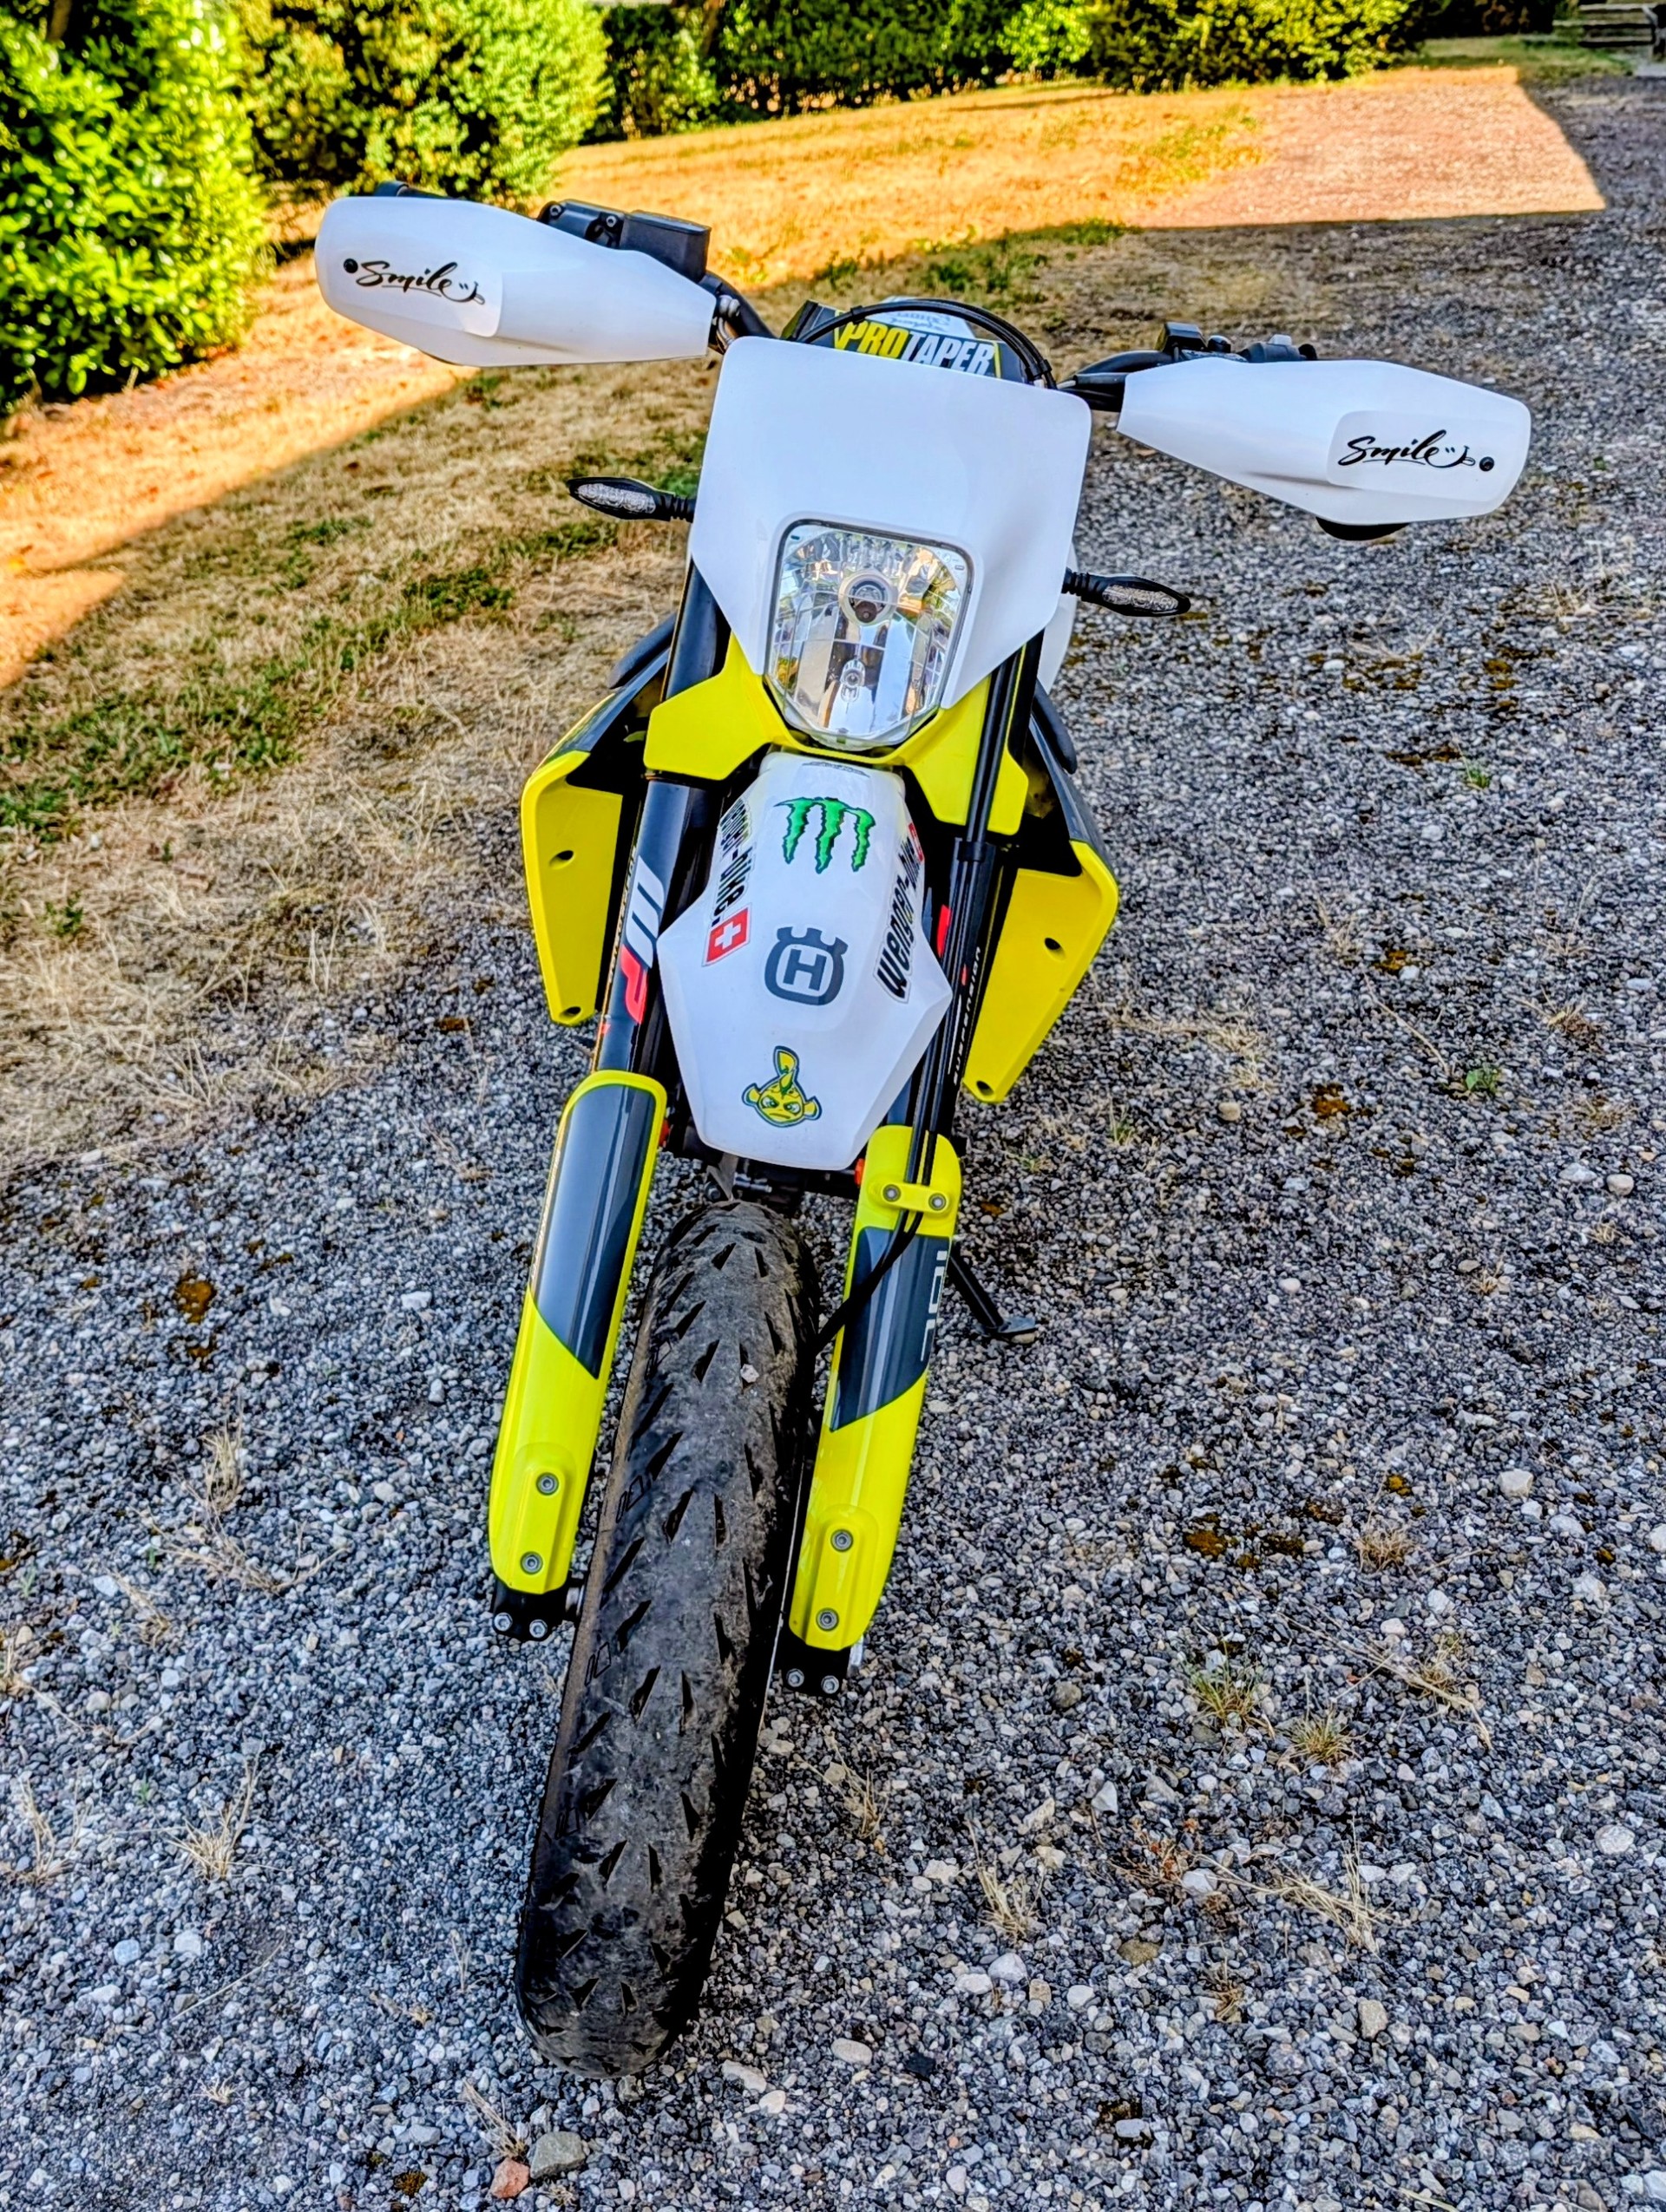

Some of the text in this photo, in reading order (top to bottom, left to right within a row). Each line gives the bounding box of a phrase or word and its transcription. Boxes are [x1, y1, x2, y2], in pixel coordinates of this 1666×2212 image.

[356, 260, 483, 304] Smile
[837, 322, 994, 375] PROTAPER
[1338, 429, 1474, 468] Smile
